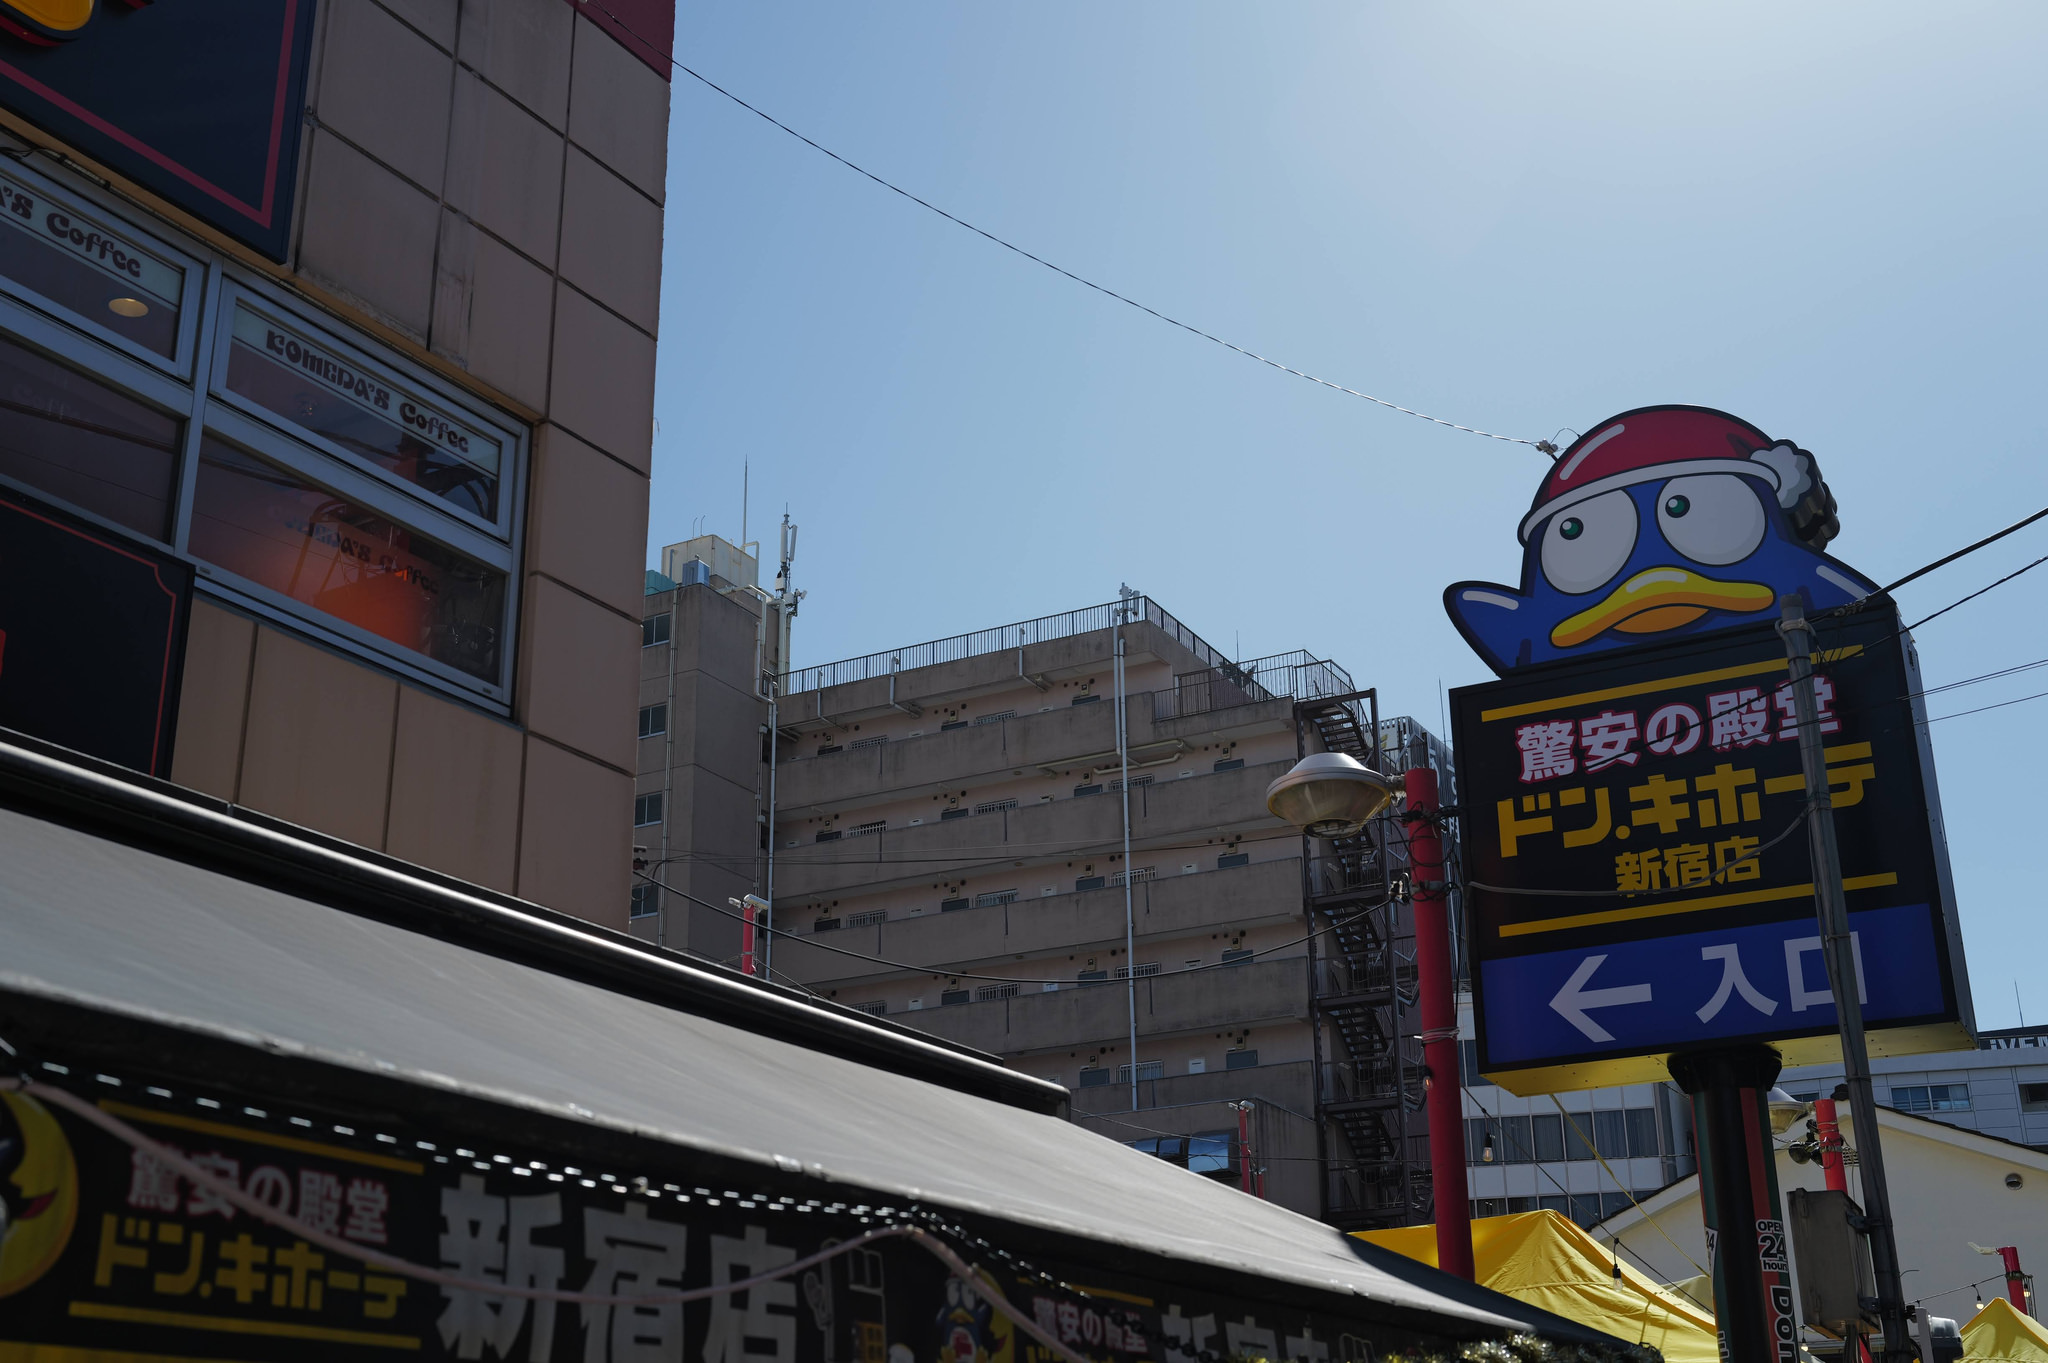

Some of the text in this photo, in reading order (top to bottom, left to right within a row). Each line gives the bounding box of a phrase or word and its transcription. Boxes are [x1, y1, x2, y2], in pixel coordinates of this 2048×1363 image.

[46, 212, 141, 278] Coffee
[265, 329, 469, 453] KOMEDA'S Coffee
[1516, 675, 1842, 783] 驚安の殿堂
[1615, 836, 1761, 898] 新宿店
[1695, 931, 1868, 1024] 入口
[128, 1140, 390, 1245] 驚安の殿堂
[435, 1173, 797, 1363] 新宿店
[1760, 1234, 1787, 1260] 24
